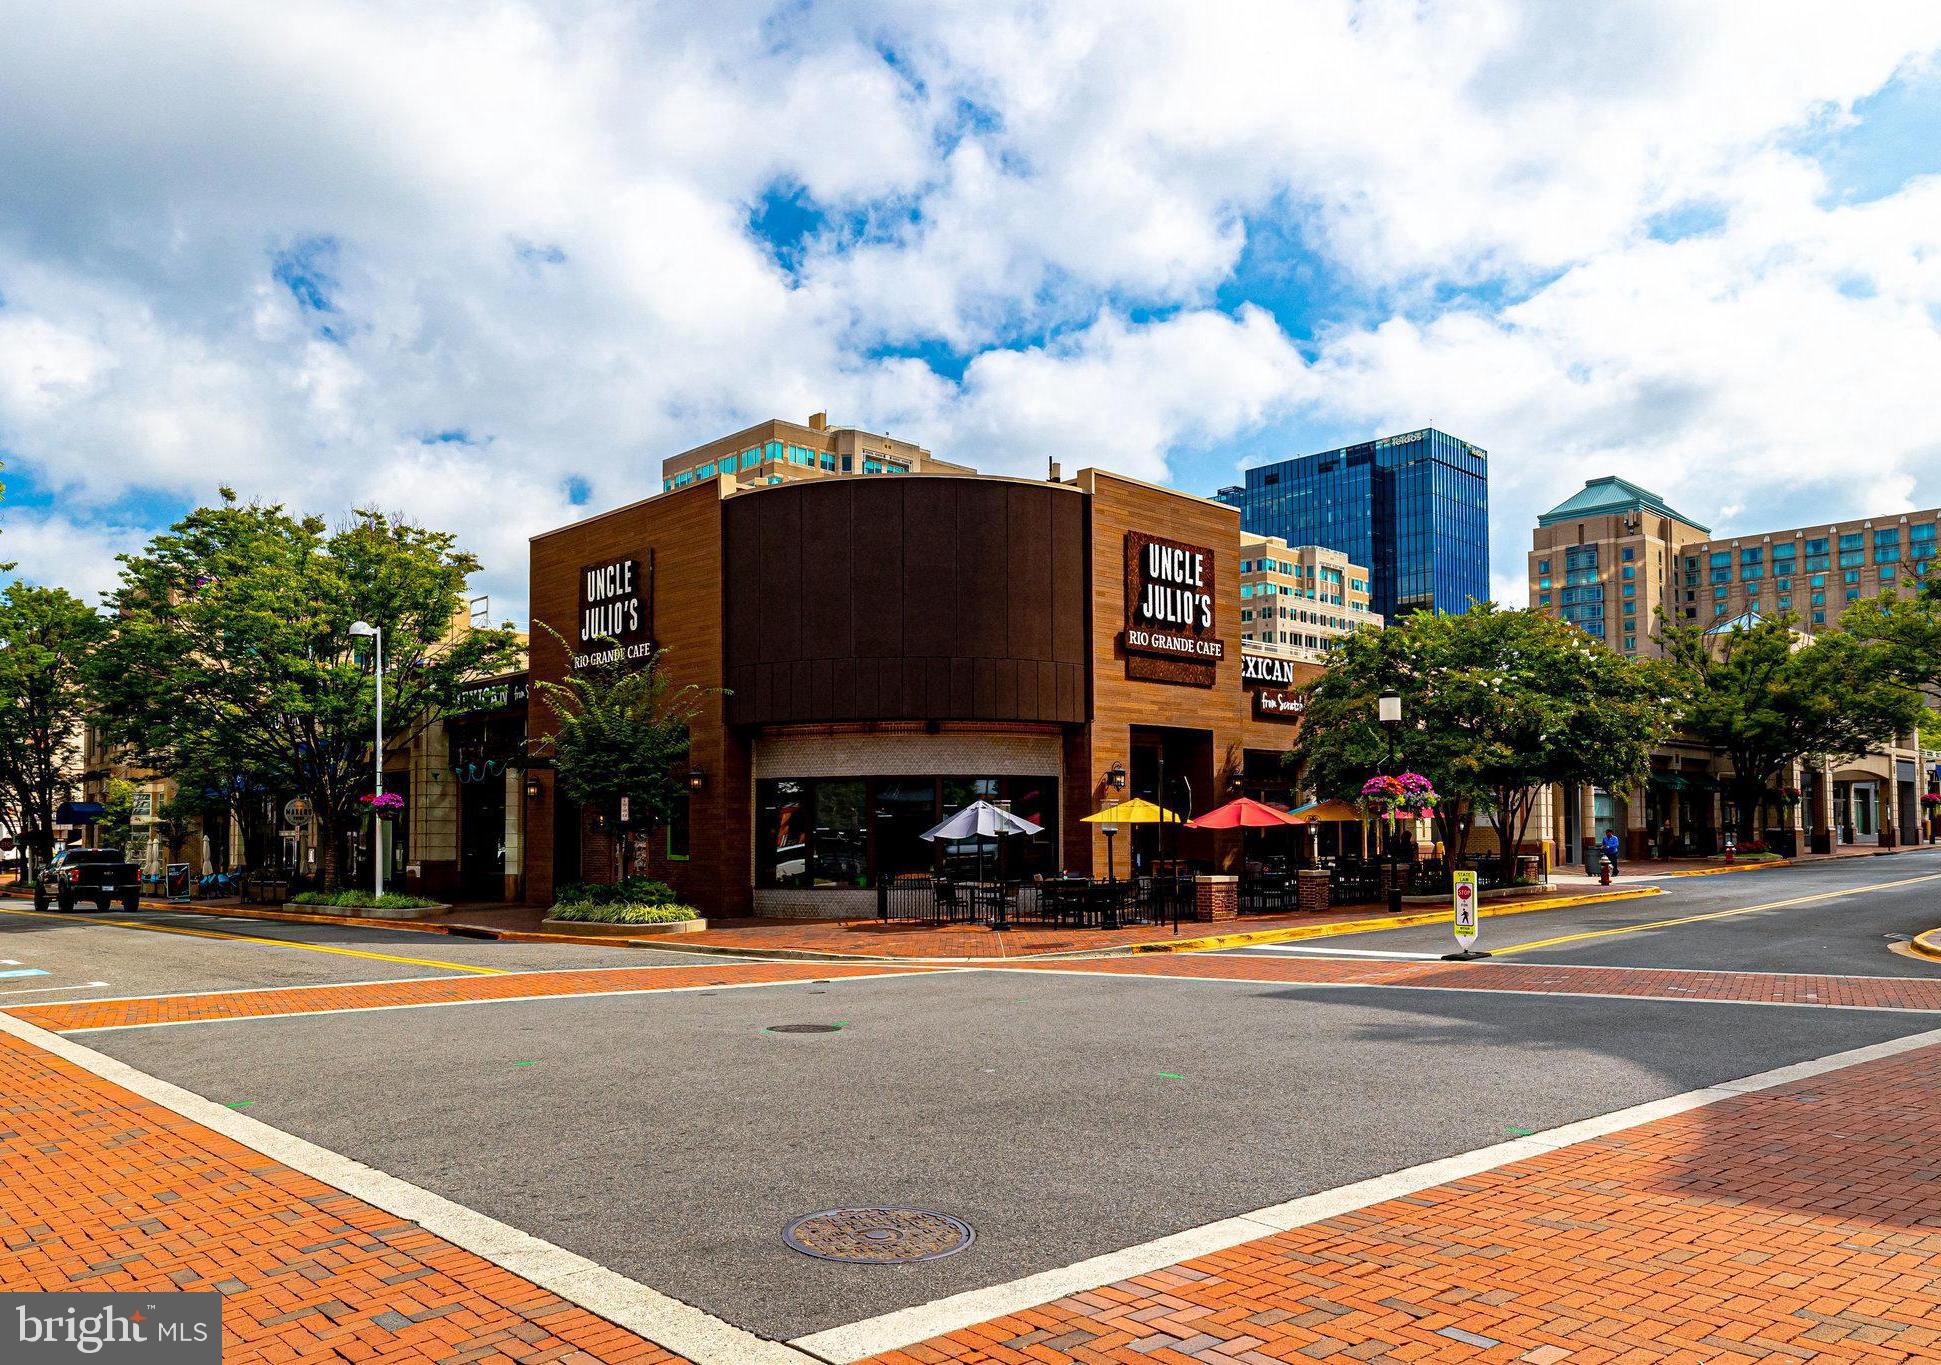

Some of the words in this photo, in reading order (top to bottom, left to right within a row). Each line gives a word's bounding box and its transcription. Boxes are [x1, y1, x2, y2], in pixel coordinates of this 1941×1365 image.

[587, 560, 632, 602] UNCLE
[1149, 543, 1204, 587] UNCLE
[581, 598, 638, 640] JULIO'S
[1142, 583, 1212, 628] JULIO'S
[574, 653, 589, 669] RIO
[590, 647, 626, 666] GRANDE
[627, 643, 651, 659] CAFE
[1129, 630, 1149, 646] RIO
[1151, 634, 1195, 653] GRANDE
[1196, 640, 1222, 657] CAFE
[1262, 692, 1277, 709] from
